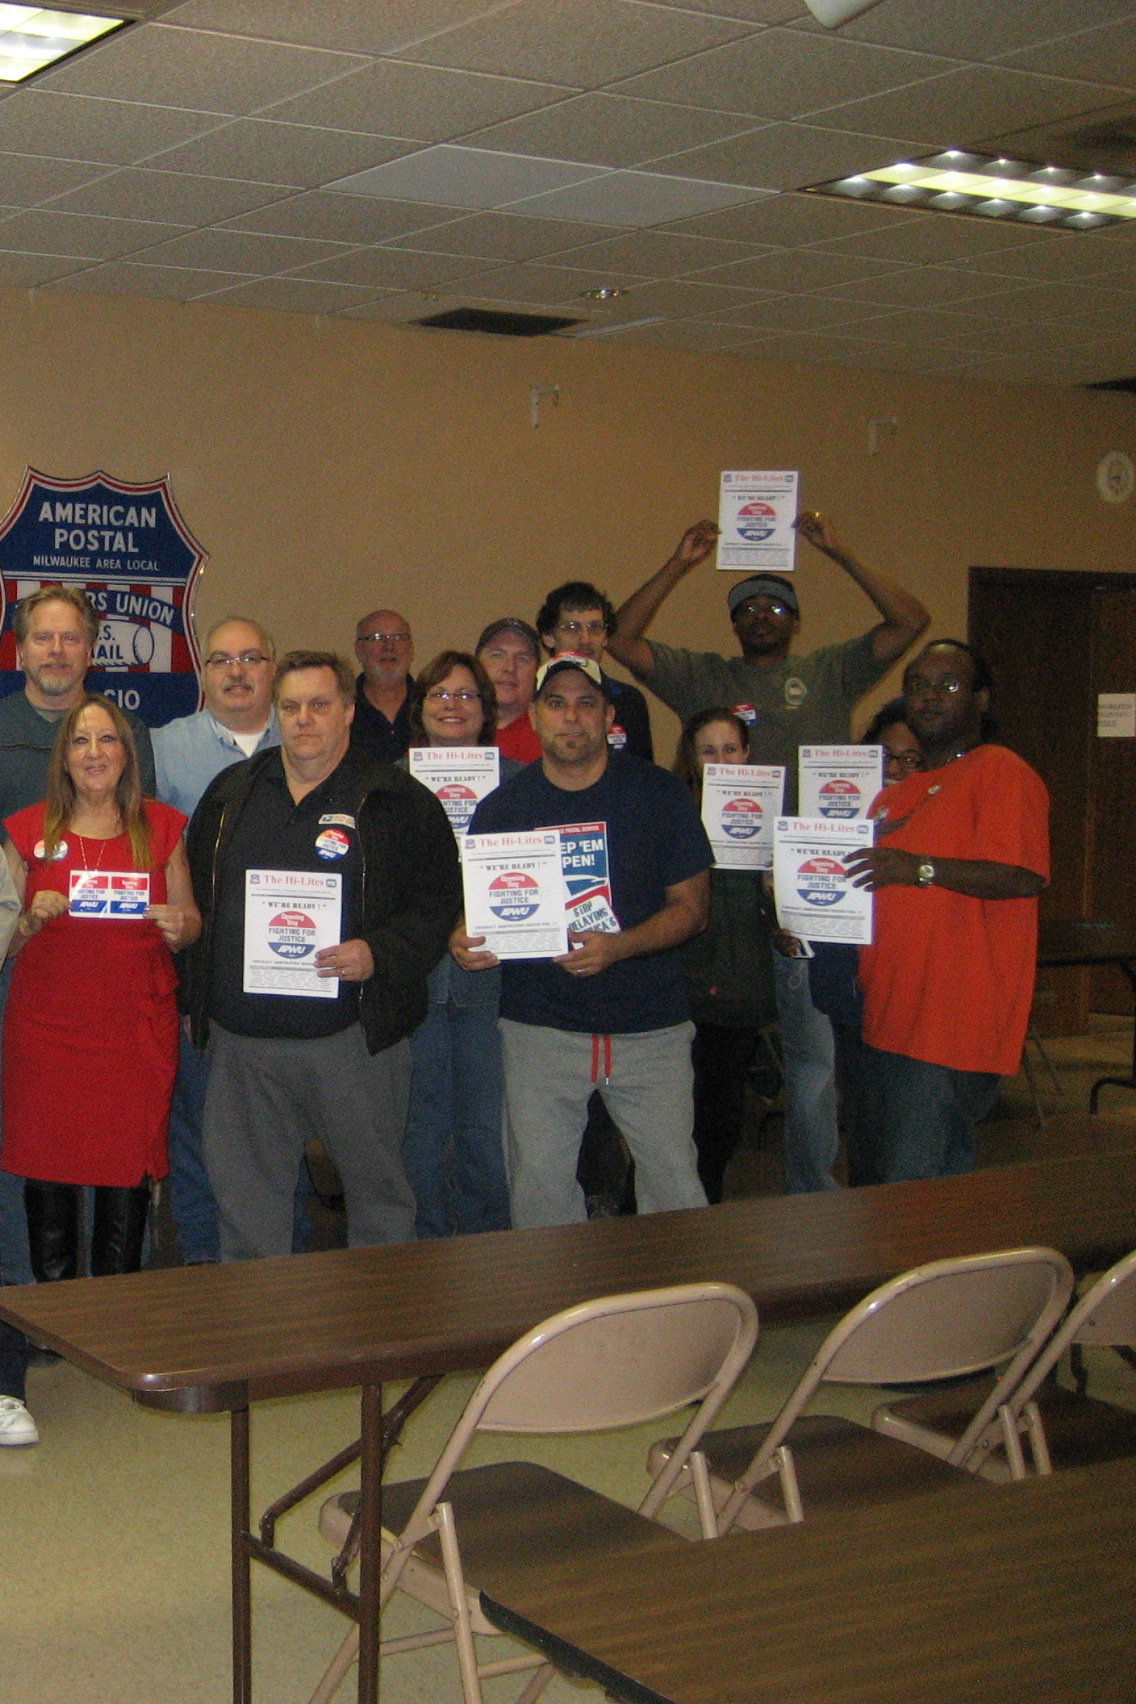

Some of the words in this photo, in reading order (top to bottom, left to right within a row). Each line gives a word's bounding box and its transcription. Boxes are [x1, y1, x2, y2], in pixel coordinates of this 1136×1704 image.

[38, 501, 157, 528] AMERICAN
[54, 528, 139, 553] POSTAL
[33, 555, 91, 568] MILWAUKEE
[96, 558, 122, 570] AREA
[127, 560, 160, 571] LOCAL
[116, 593, 175, 626] UNION
[92, 645, 124, 659] AIL
[426, 752, 444, 760] The
[446, 751, 483, 759] Hi-Lites
[792, 822, 811, 831] The
[814, 823, 855, 833] Hi-Lites
[479, 838, 499, 847] The
[501, 836, 542, 846] Hi-Lites
[560, 841, 577, 854] EP
[579, 839, 604, 853] 'EM
[486, 863, 510, 871] WE'RE
[512, 862, 537, 870] READY
[562, 854, 595, 868] PEN!
[264, 875, 282, 884] The
[285, 876, 324, 887] Hi-Lites
[489, 890, 523, 898] FIGHTING
[292, 902, 316, 910] READY
[500, 897, 529, 905] JUSTICE
[500, 906, 530, 917] APWU
[573, 901, 592, 918] STOP
[277, 945, 307, 954] APWU
